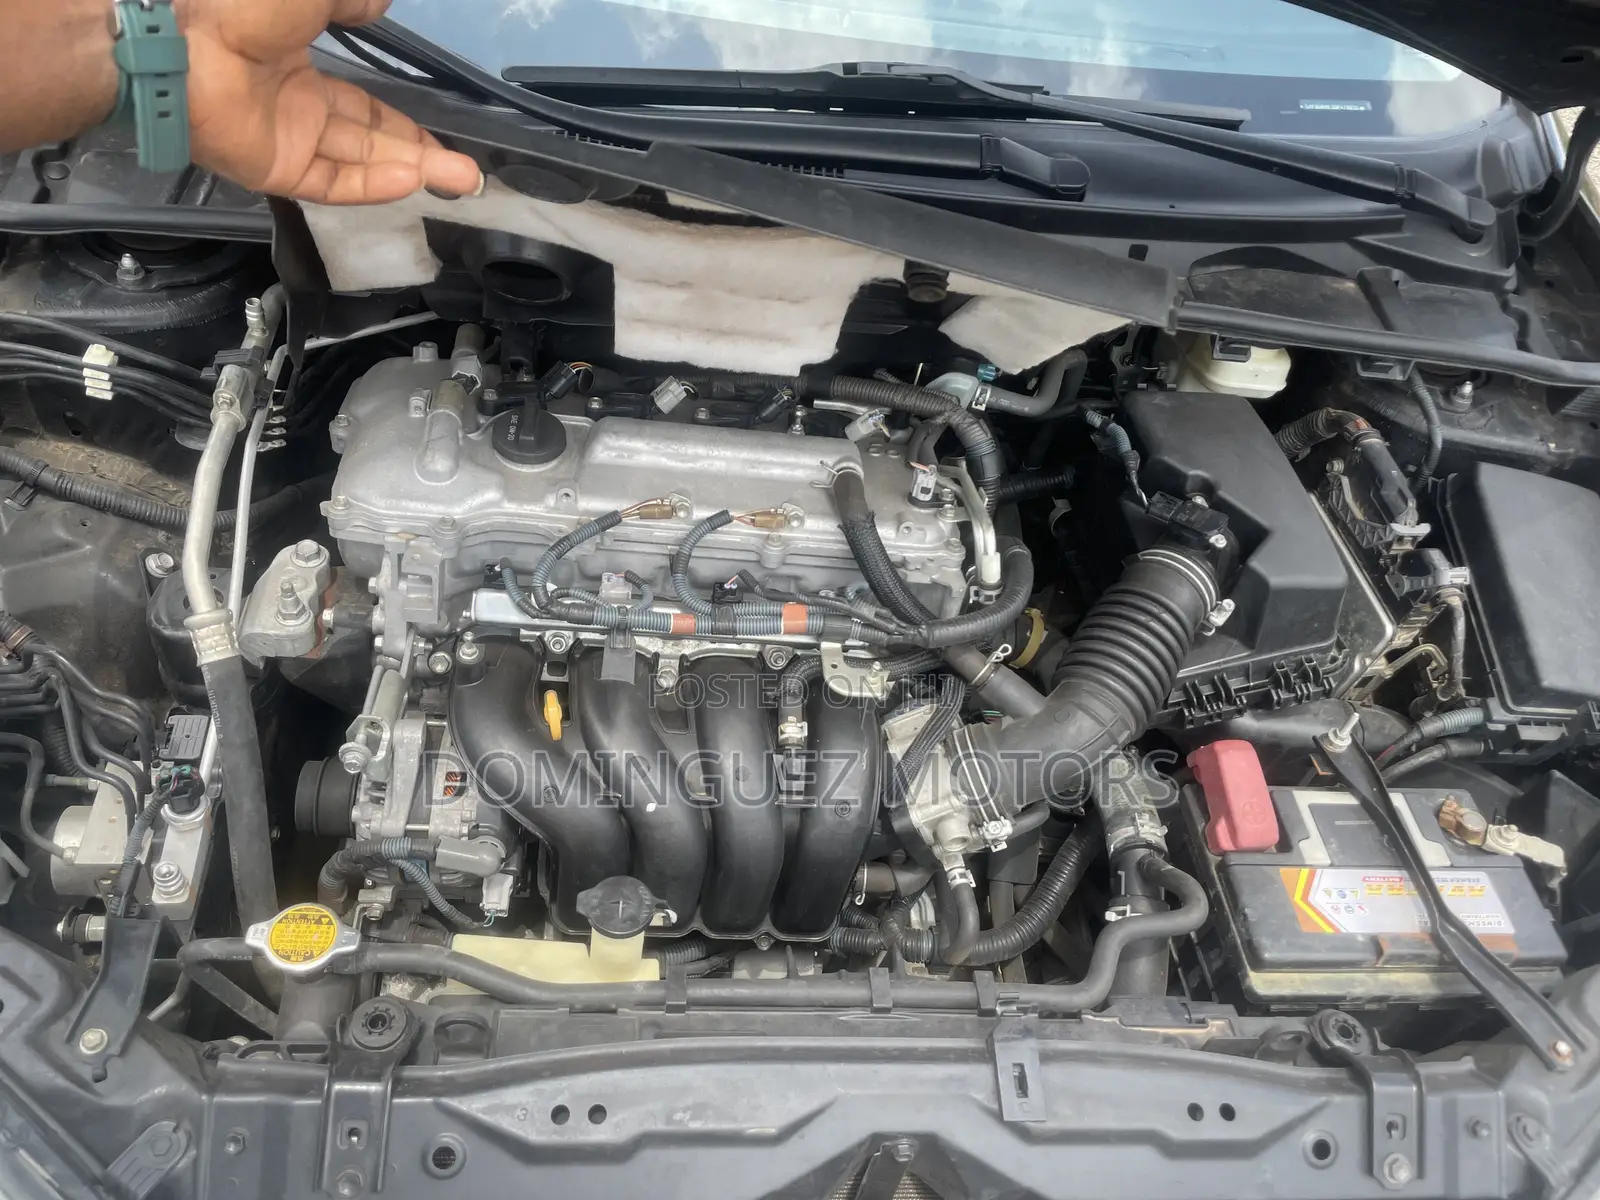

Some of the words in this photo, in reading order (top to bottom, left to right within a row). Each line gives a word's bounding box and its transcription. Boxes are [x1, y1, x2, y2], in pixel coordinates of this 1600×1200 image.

[508, 425, 516, 440] 0W-20
[207, 689, 221, 728] NICHIRIN
[278, 949, 311, 957] CAUTION
